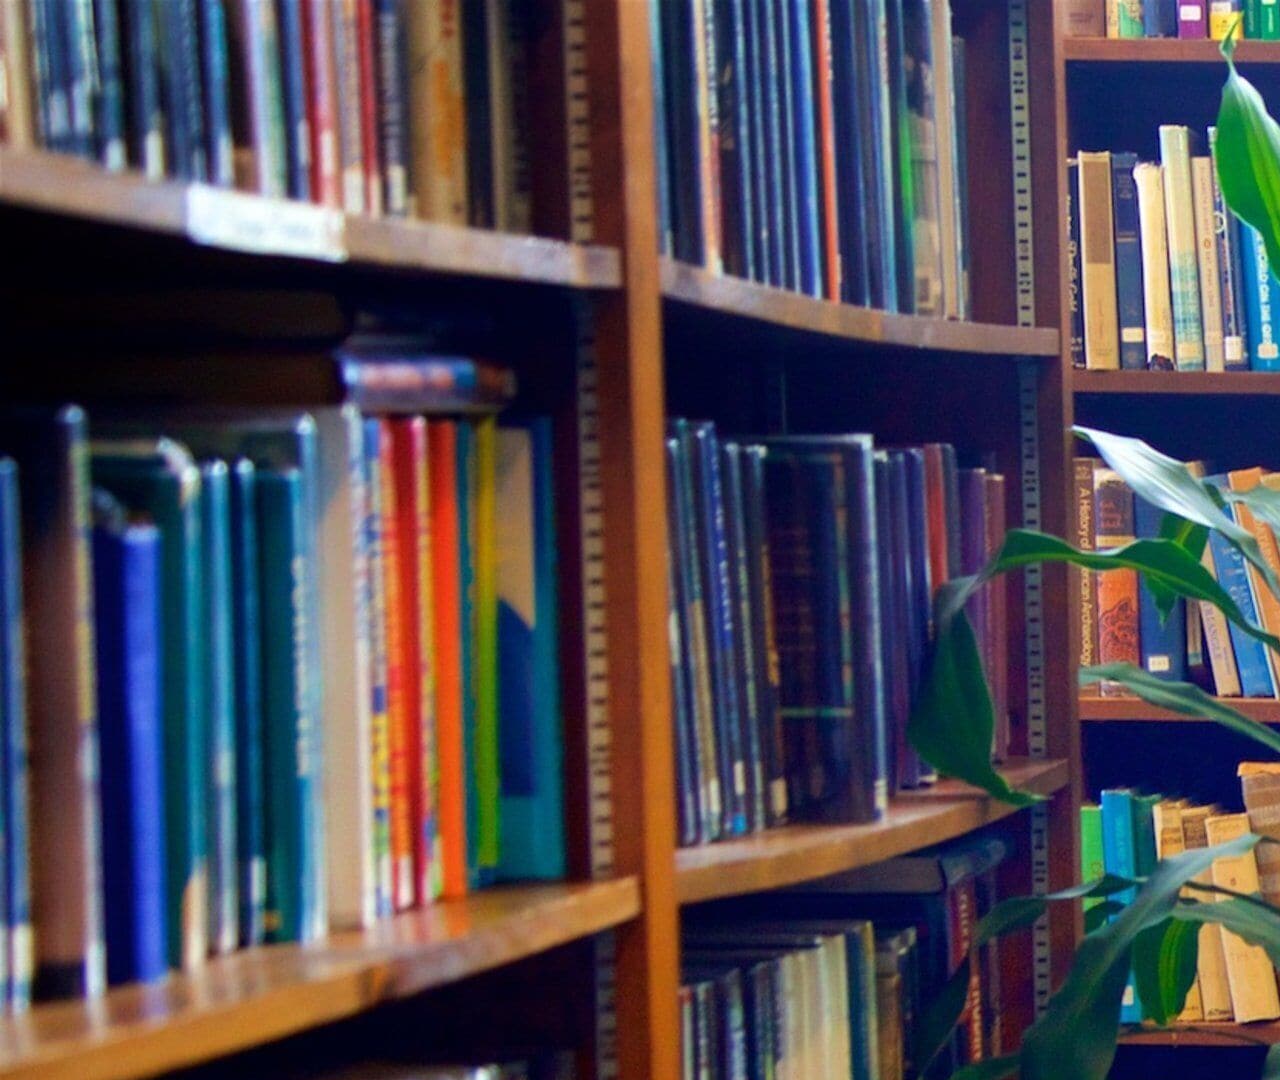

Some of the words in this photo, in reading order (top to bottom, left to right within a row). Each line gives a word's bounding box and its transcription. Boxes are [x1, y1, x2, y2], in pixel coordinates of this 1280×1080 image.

[1080, 489, 1090, 498] A
[1079, 499, 1091, 533] History
[1079, 535, 1091, 549] of
[1078, 602, 1093, 667] Archaeology
